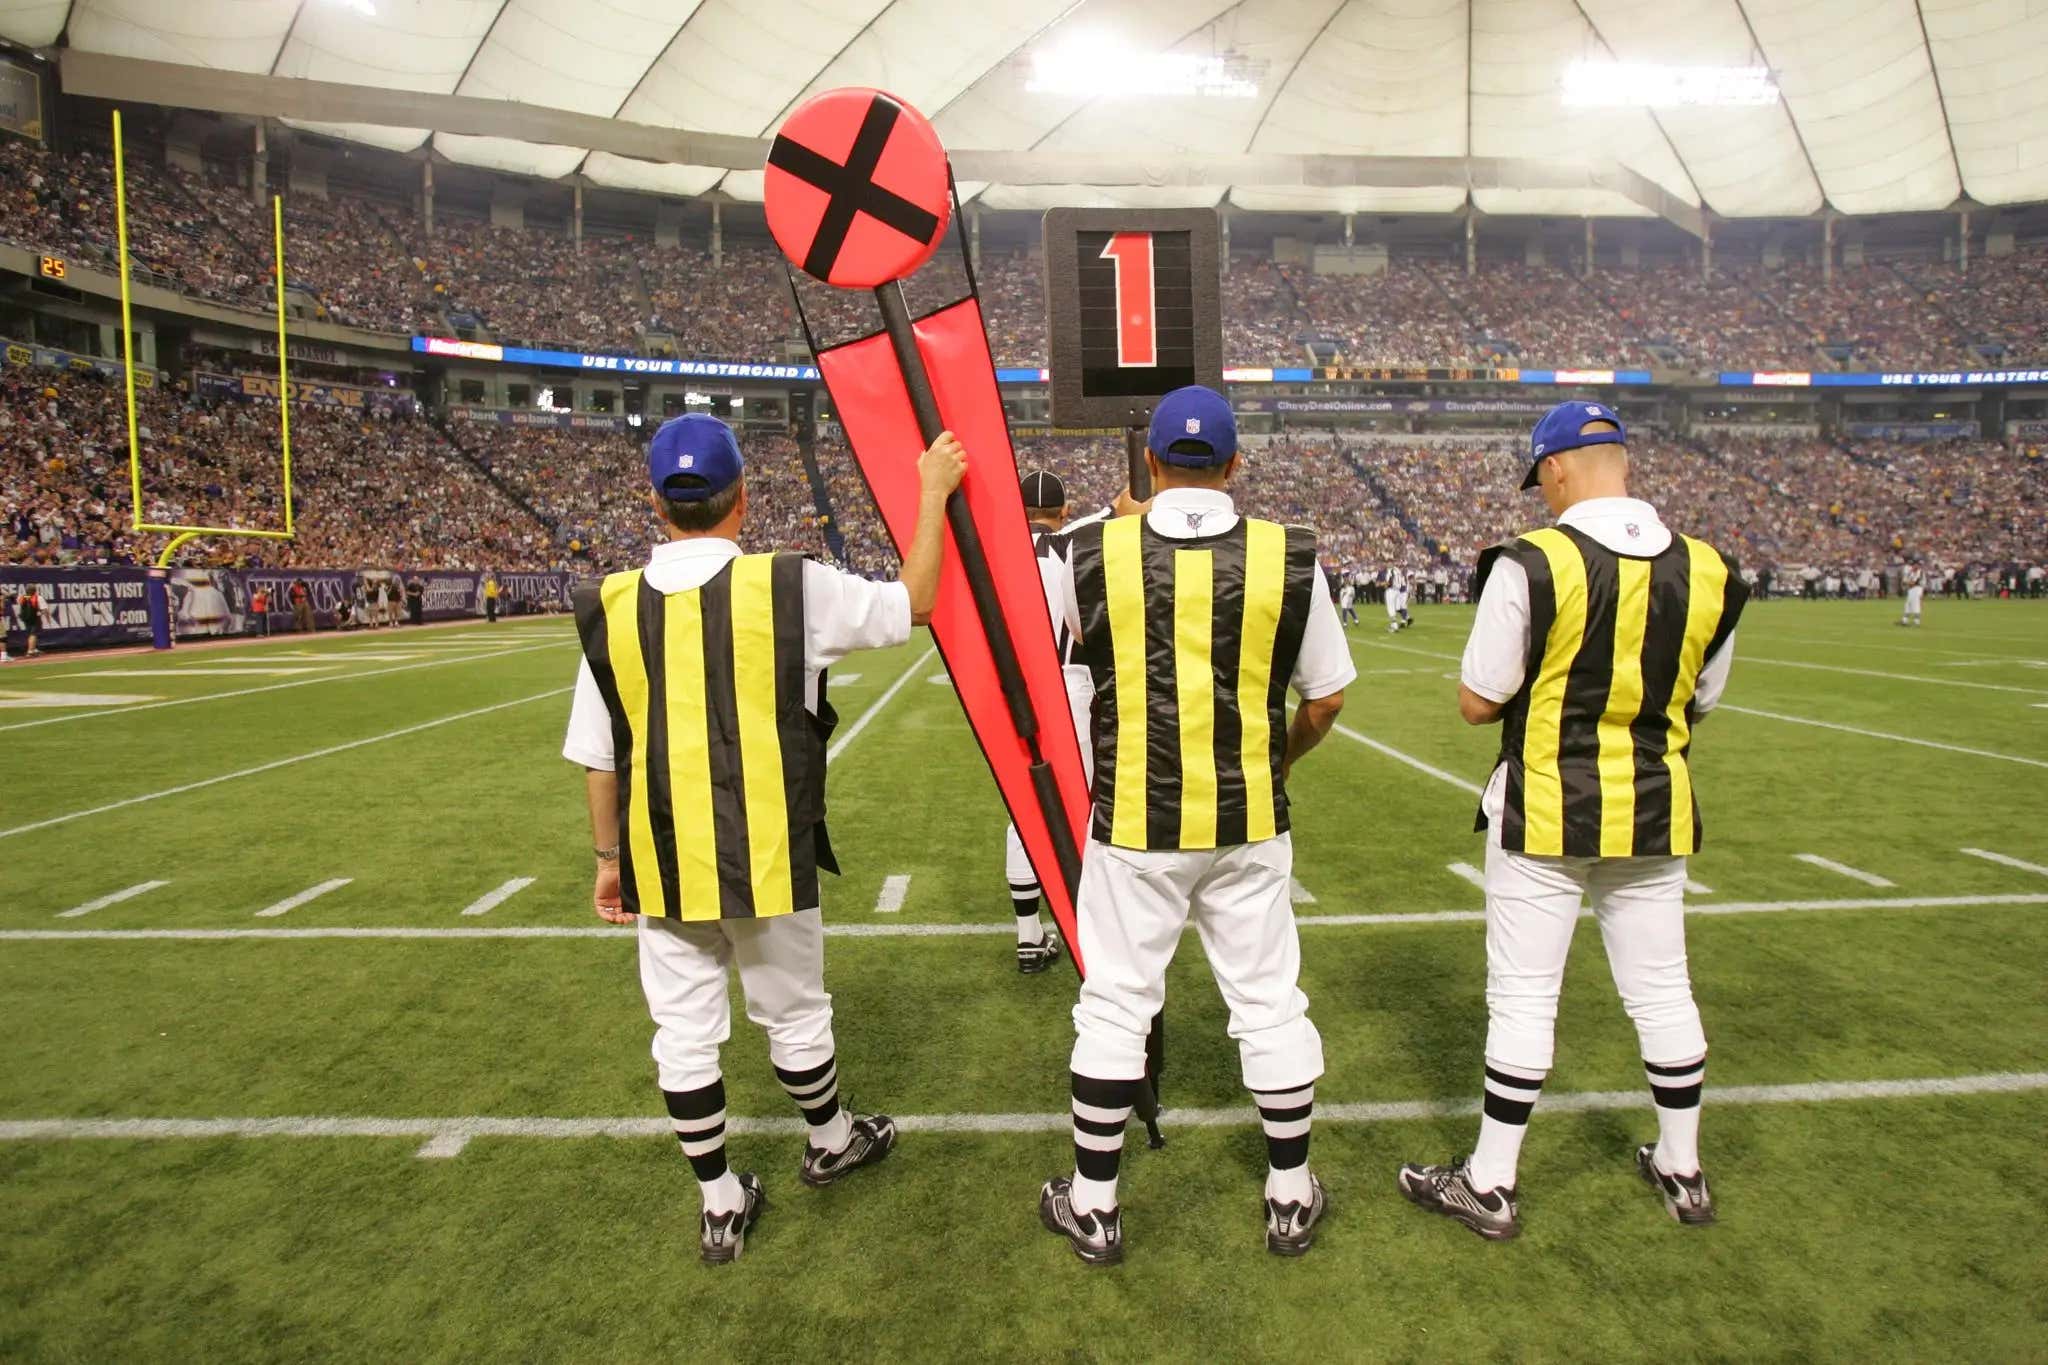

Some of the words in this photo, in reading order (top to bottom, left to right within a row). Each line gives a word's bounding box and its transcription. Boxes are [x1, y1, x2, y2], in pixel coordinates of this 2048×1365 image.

[43, 256, 65, 277] 25
[1099, 231, 1157, 368] 1
[582, 355, 619, 369] USE
[624, 359, 674, 373] YOUR
[679, 362, 799, 378] MASTERCARD
[1881, 373, 1914, 385] USE
[1918, 373, 1962, 385] YOUR
[0, 583, 54, 600] SEAON
[58, 582, 111, 600] TICKETS
[113, 582, 144, 598] VISIT
